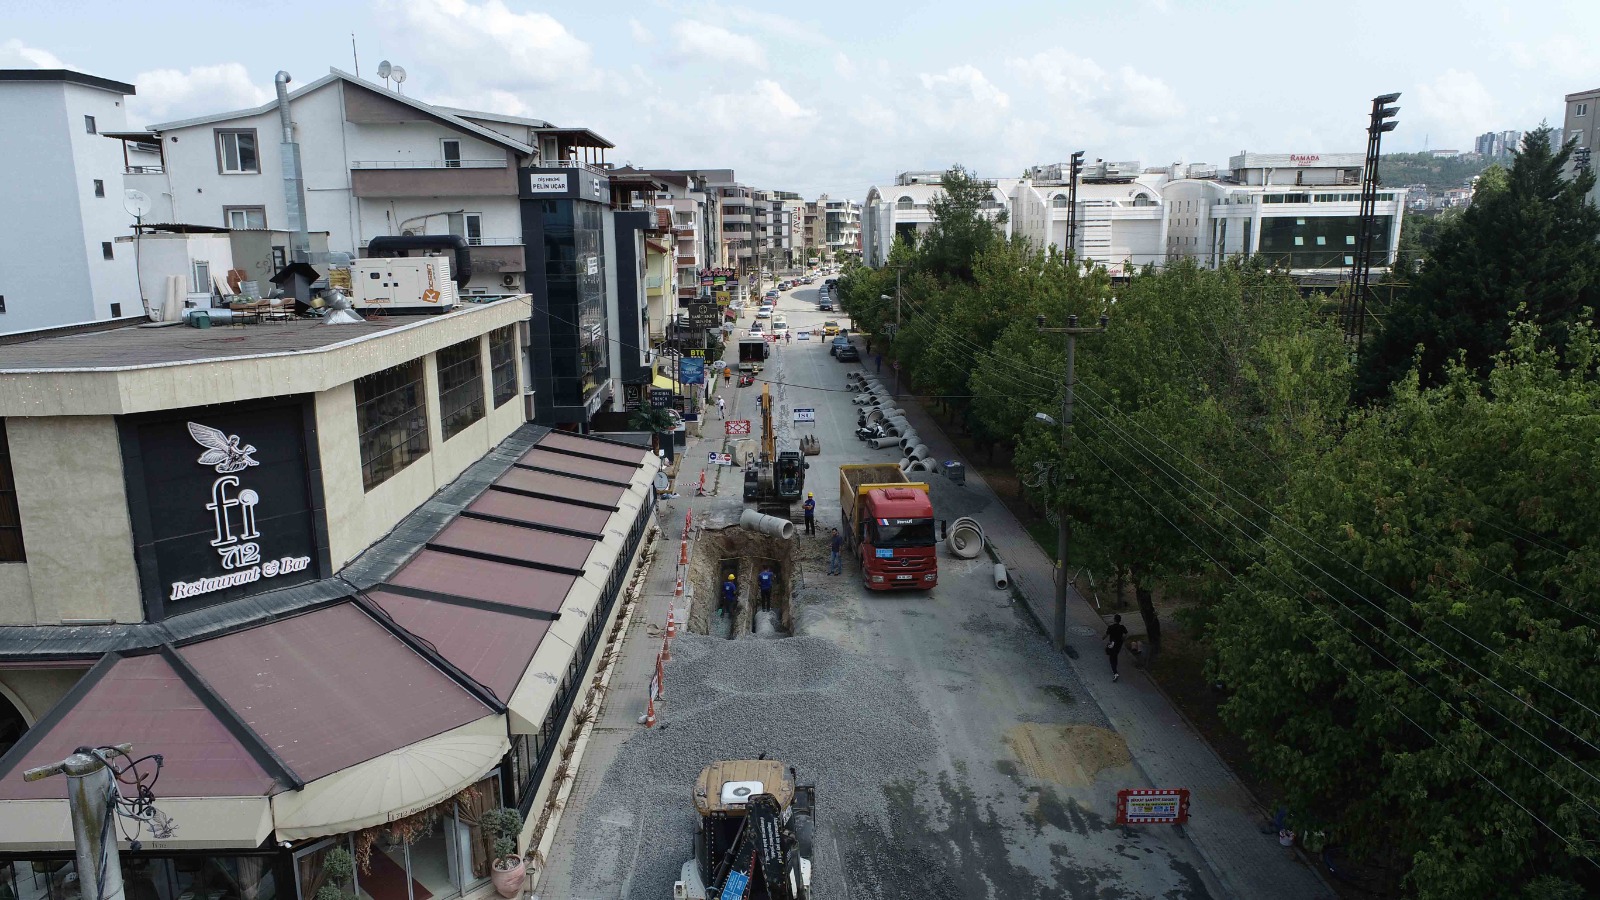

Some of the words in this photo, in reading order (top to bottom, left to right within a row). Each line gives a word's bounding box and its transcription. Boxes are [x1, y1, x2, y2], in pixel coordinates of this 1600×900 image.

[217, 542, 261, 570] 712
[169, 567, 261, 601] Restaurant
[261, 560, 280, 578] &
[279, 556, 311, 576] Bar
